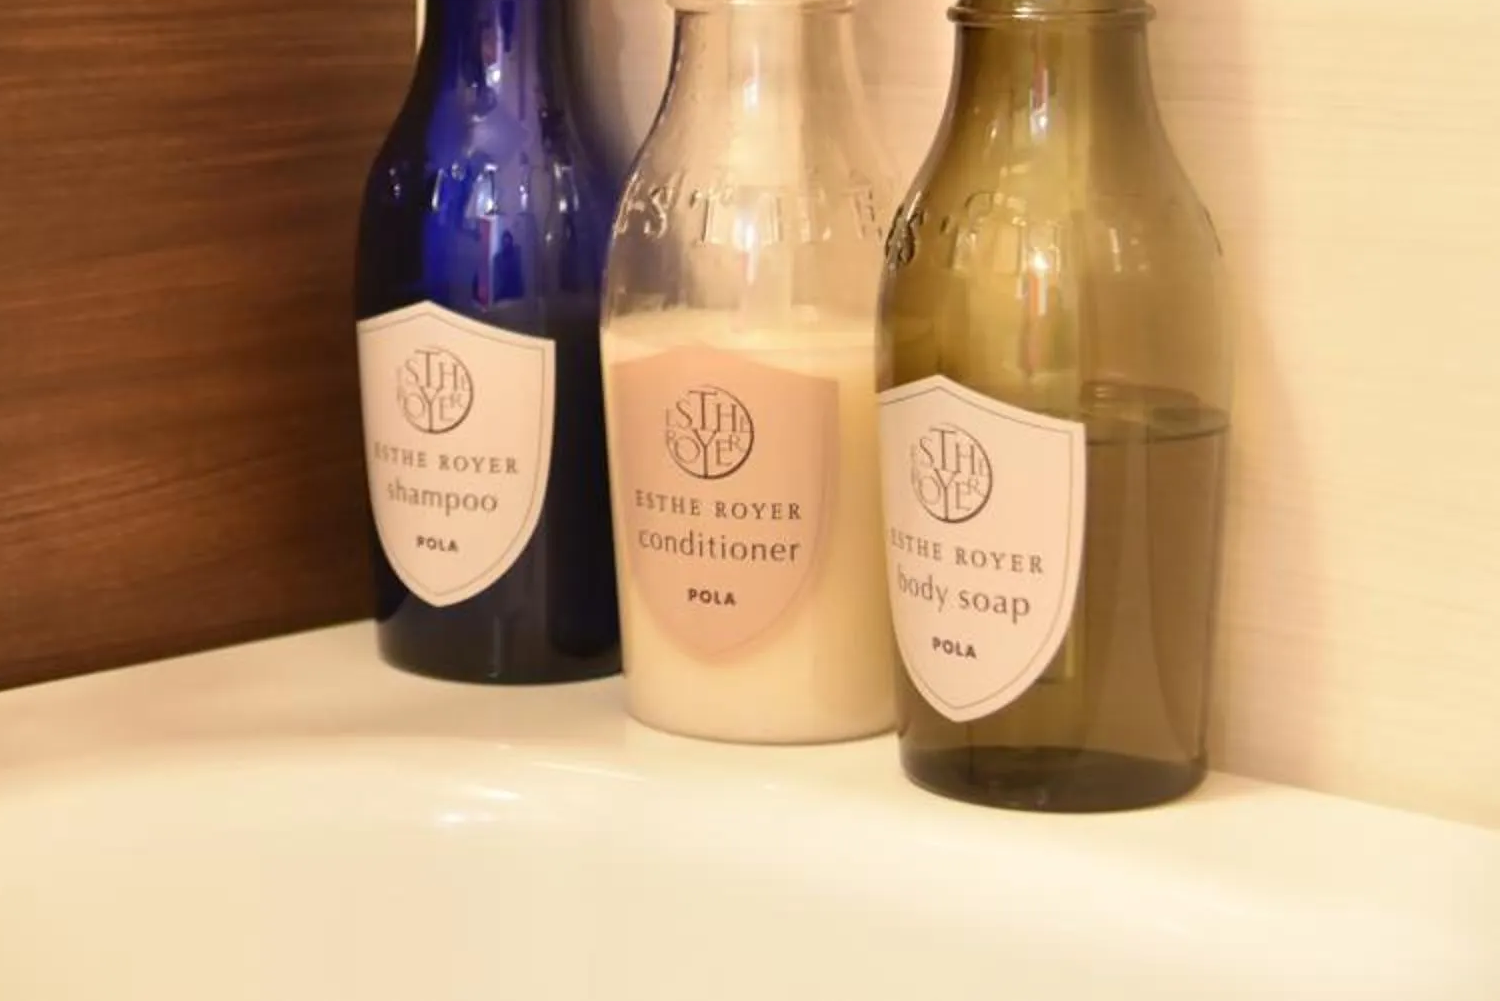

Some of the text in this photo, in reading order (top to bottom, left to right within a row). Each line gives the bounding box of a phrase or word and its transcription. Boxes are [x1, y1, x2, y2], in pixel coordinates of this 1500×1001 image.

[373, 441, 519, 475] ESTHE ROYER
[387, 475, 499, 517] shampoo
[634, 489, 802, 521] ESTHE ROYER
[415, 534, 459, 553] POLA
[638, 528, 801, 562] conditioner
[889, 528, 1044, 574] ESTHE ROYER
[687, 587, 737, 606] POLA
[896, 562, 1031, 624] body soap
[931, 636, 977, 659] POLA
